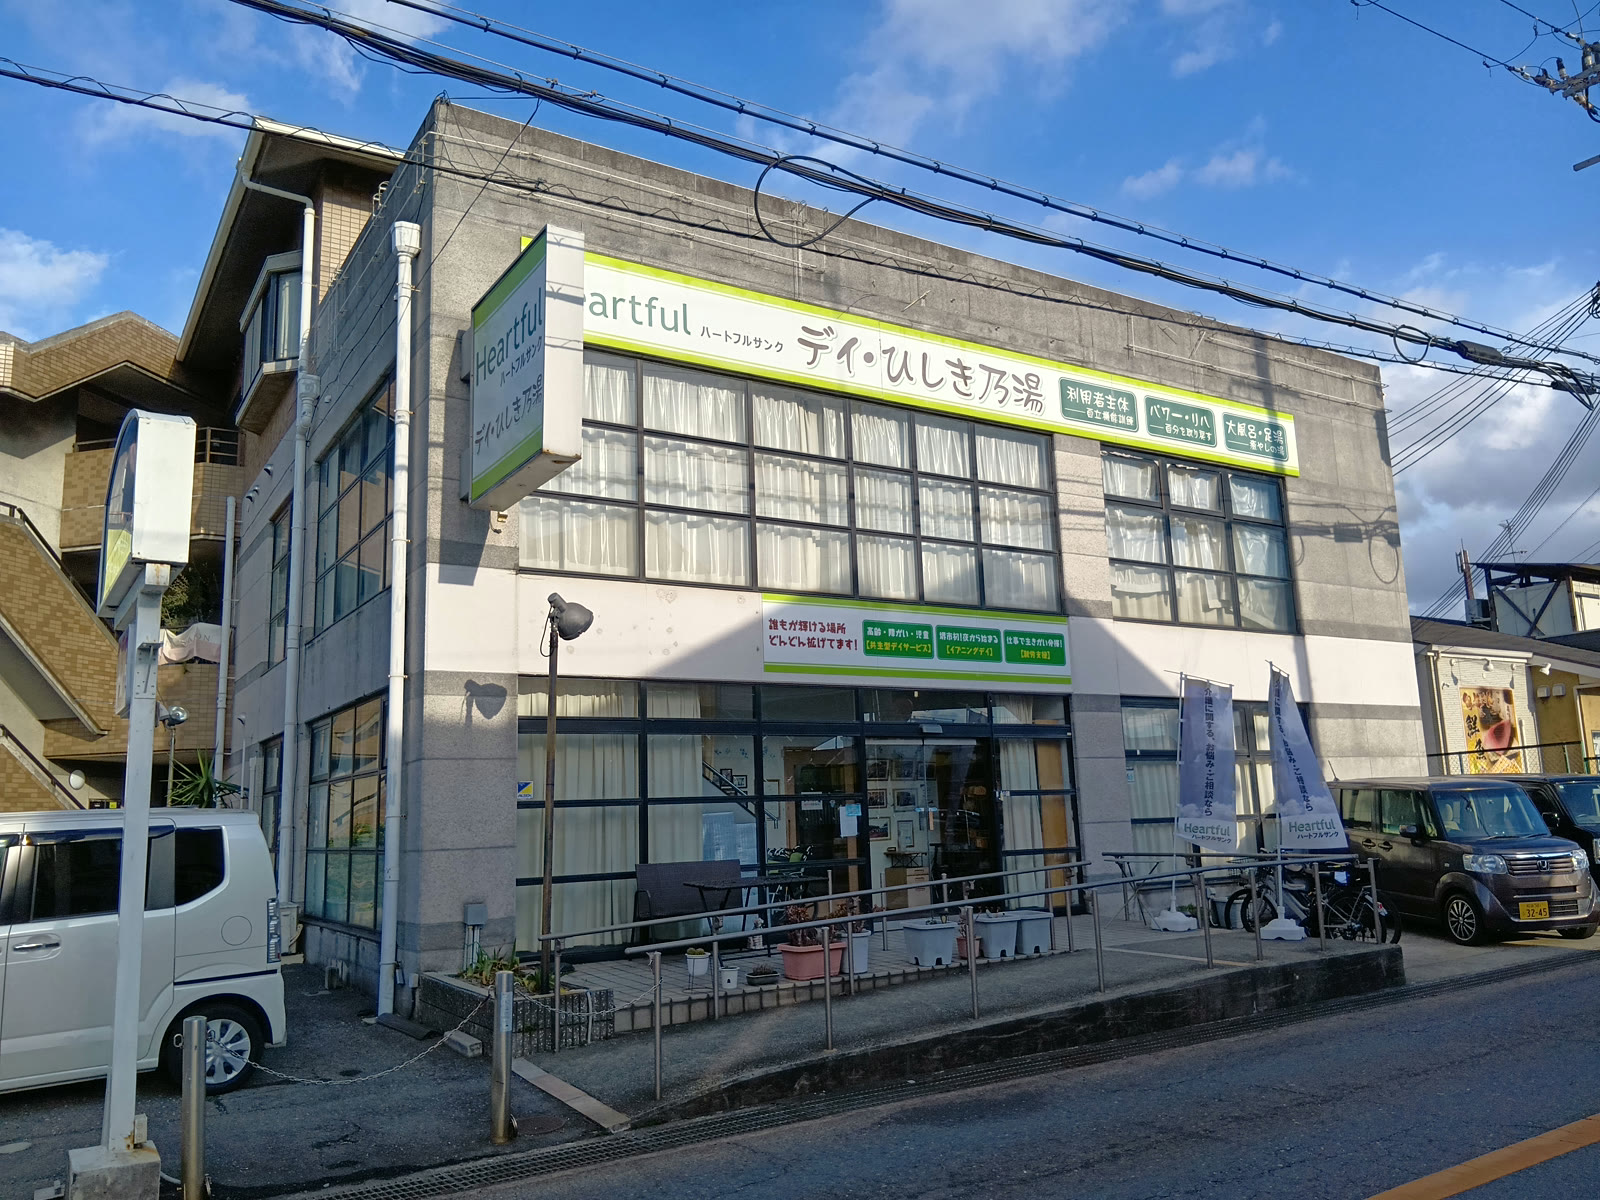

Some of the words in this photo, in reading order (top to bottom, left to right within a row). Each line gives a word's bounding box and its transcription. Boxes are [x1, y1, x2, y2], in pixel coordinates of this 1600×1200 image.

[583, 292, 691, 335] artful
[476, 287, 542, 386] Heartful
[700, 325, 784, 352] ハートフルサンク
[500, 336, 542, 387] ハートフルサンク
[1066, 385, 1130, 413] 利用者主体
[1086, 407, 1134, 426] 自立機能訓練
[1150, 404, 1211, 429] パワー・リハ
[1165, 423, 1212, 441] 自分を取り戻す
[1226, 419, 1284, 445] 大風呂・足湯
[768, 618, 846, 635] 誰もが輝ける場所
[866, 626, 930, 640] 高齢・障がい・児童
[768, 634, 858, 651] どんどん拡げてます!
[1184, 823, 1230, 836] Heartful
[1289, 818, 1336, 833] Heartful
